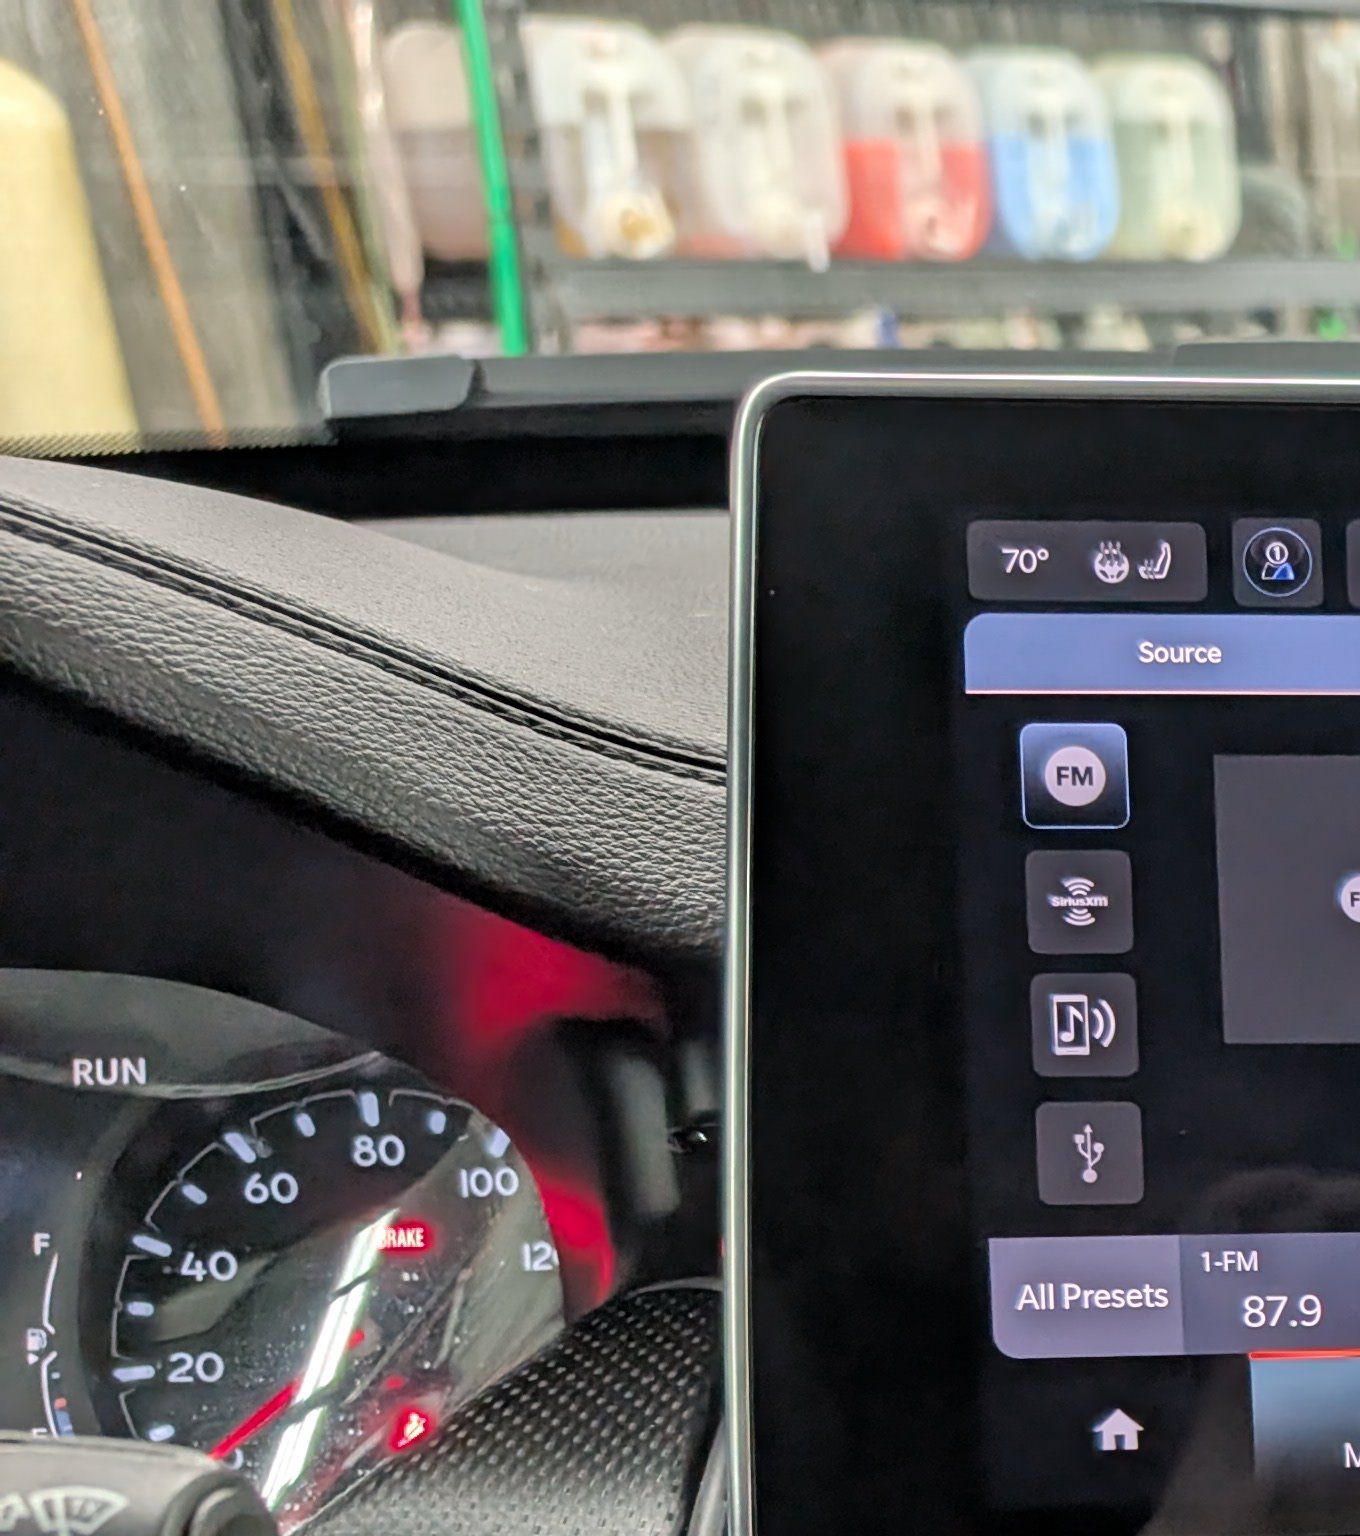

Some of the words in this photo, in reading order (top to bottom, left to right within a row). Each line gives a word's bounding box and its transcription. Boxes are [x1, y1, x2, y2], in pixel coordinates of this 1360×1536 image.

[1001, 547, 1050, 574] 70°
[1138, 641, 1223, 666] Source
[1055, 766, 1094, 788] FM
[72, 1058, 147, 1085] RUN
[352, 1135, 405, 1168] 80
[243, 1173, 299, 1205] 60
[458, 1168, 519, 1198] 100
[33, 1232, 50, 1257] F
[520, 1239, 559, 1273] 12
[179, 1250, 238, 1281] 40
[1200, 1251, 1259, 1274] 1-FM
[1016, 1284, 1058, 1312] All
[1062, 1281, 1169, 1311] Presets
[1241, 1294, 1322, 1329] 87.9
[167, 1352, 225, 1384] 20
